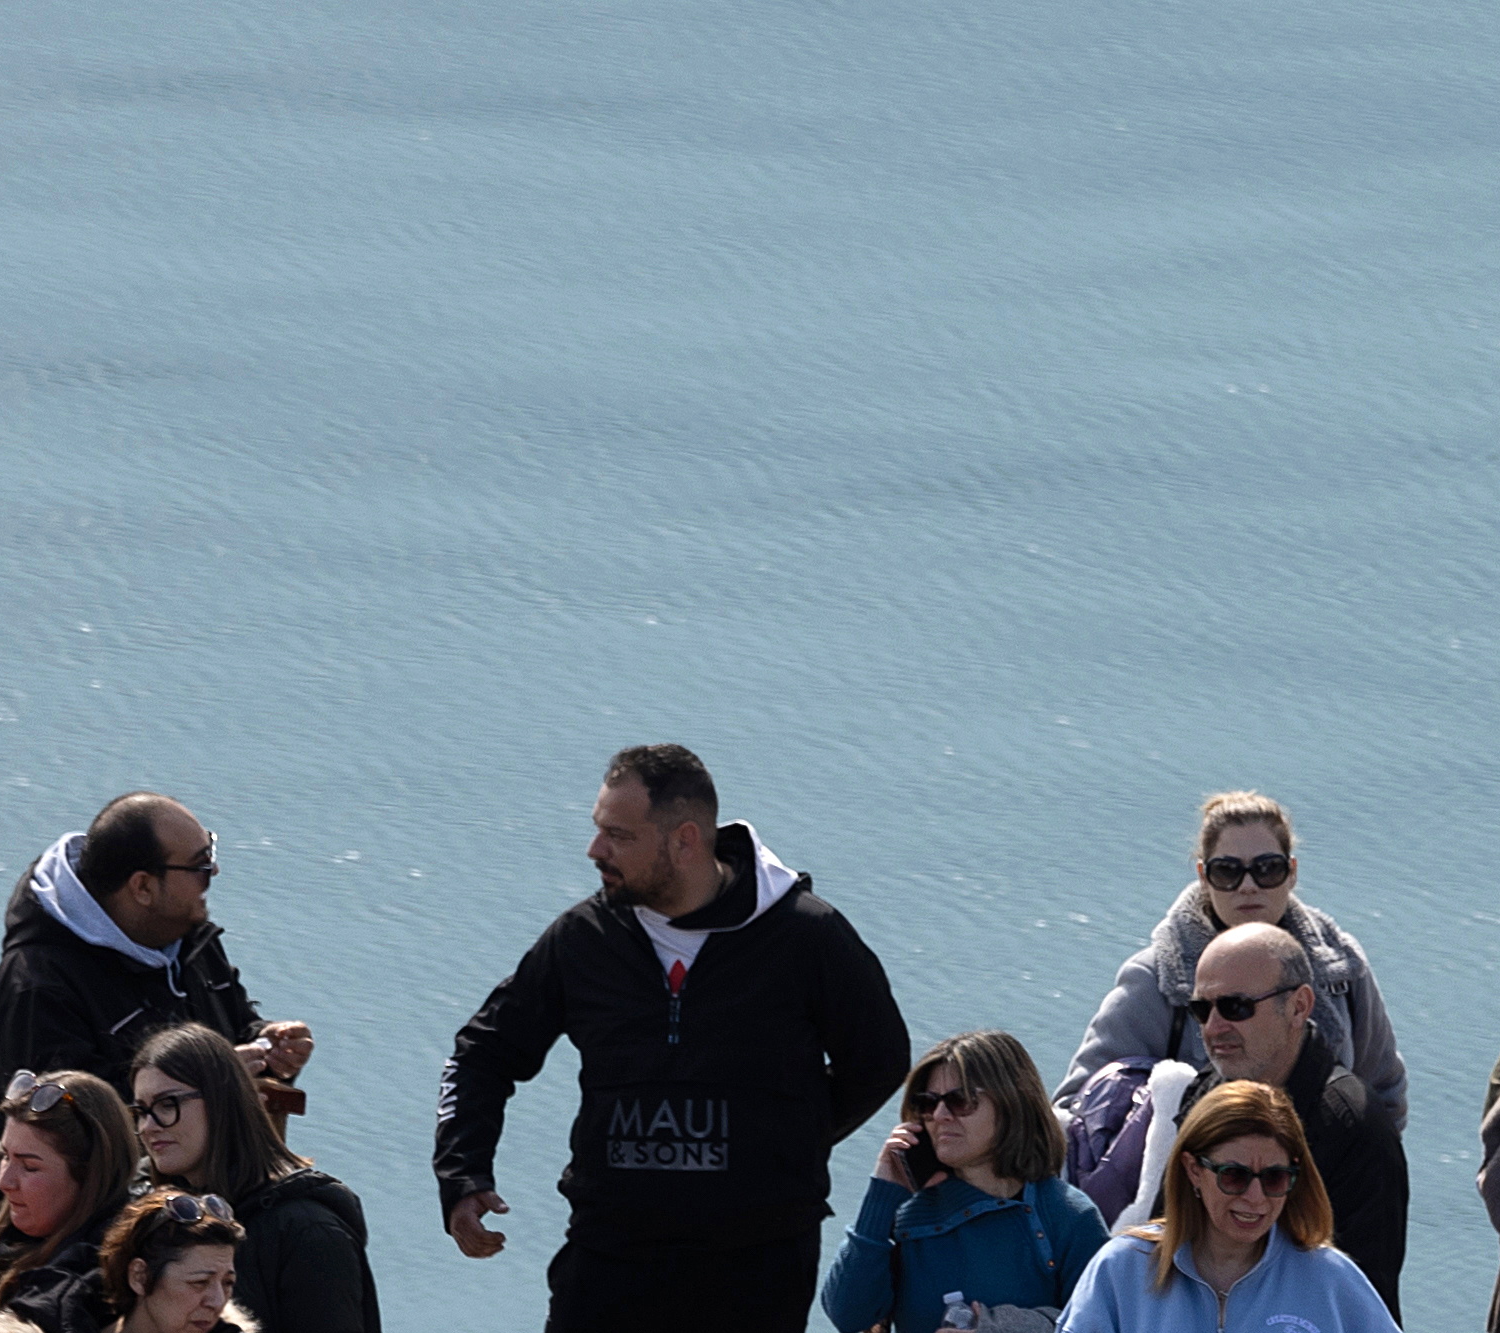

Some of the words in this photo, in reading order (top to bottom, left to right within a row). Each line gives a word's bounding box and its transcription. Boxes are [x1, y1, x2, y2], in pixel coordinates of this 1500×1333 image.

[608, 1099, 728, 1139] MAUI
[610, 1141, 626, 1166] &
[634, 1141, 724, 1166] SONS
